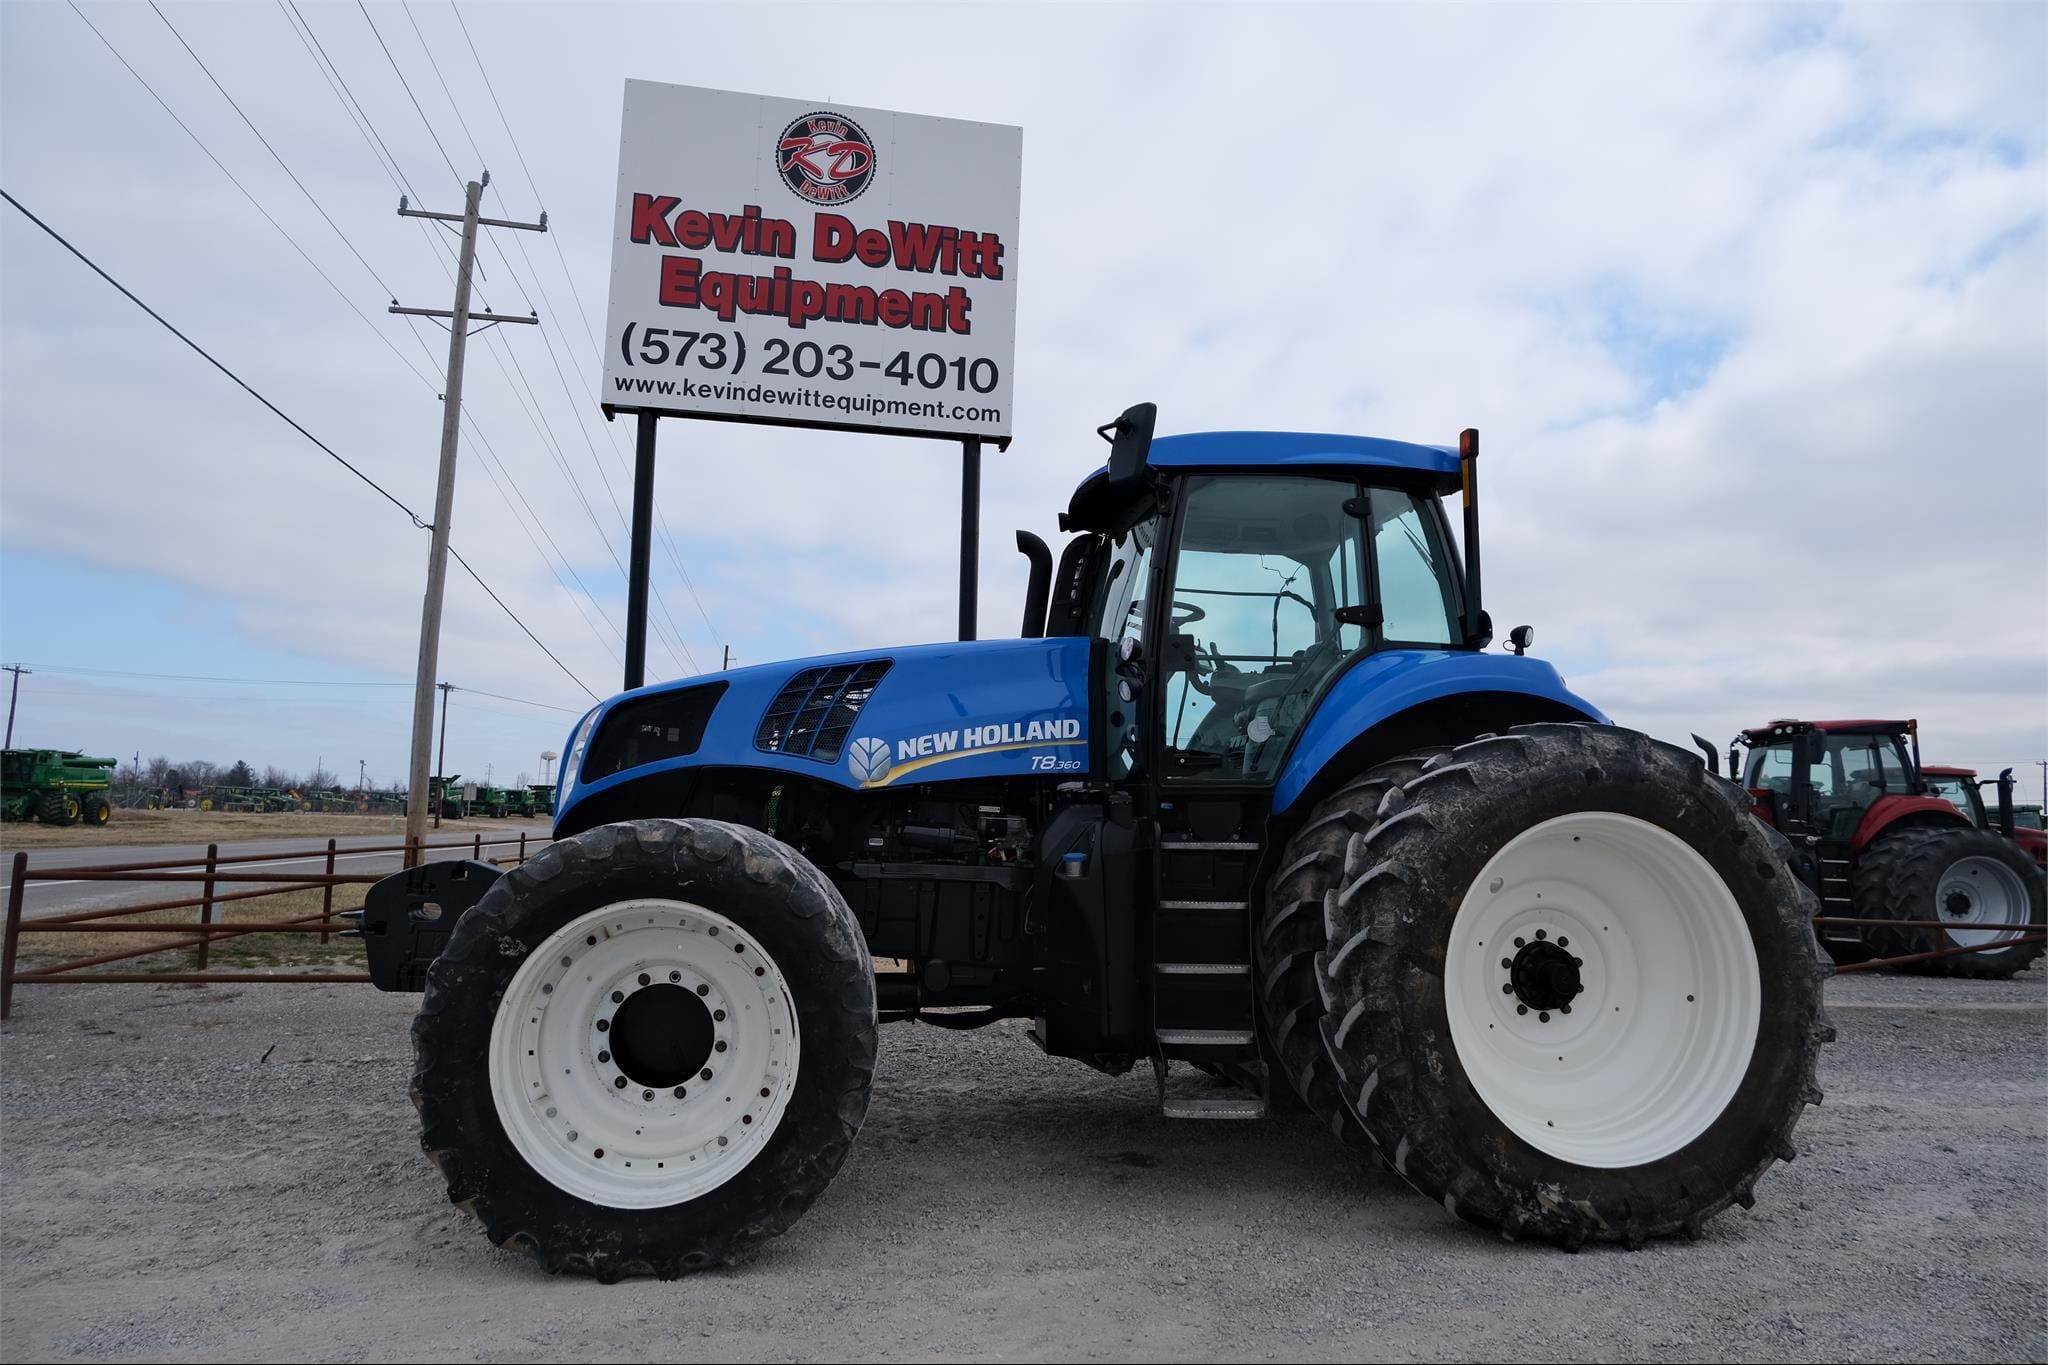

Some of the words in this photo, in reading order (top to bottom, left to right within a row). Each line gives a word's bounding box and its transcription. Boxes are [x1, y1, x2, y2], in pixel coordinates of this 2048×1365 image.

[807, 119, 849, 137] Kevin
[799, 179, 849, 200] DeWitt
[630, 192, 797, 259] Kevin
[812, 212, 1005, 281] DeWitt
[659, 255, 972, 335] Equipment
[621, 322, 746, 375] (573)
[761, 338, 999, 394] 203-4010
[614, 376, 1001, 423] www.kevindewittequipment.com
[898, 730, 958, 761] NEW
[963, 719, 1081, 749] HOLLAND
